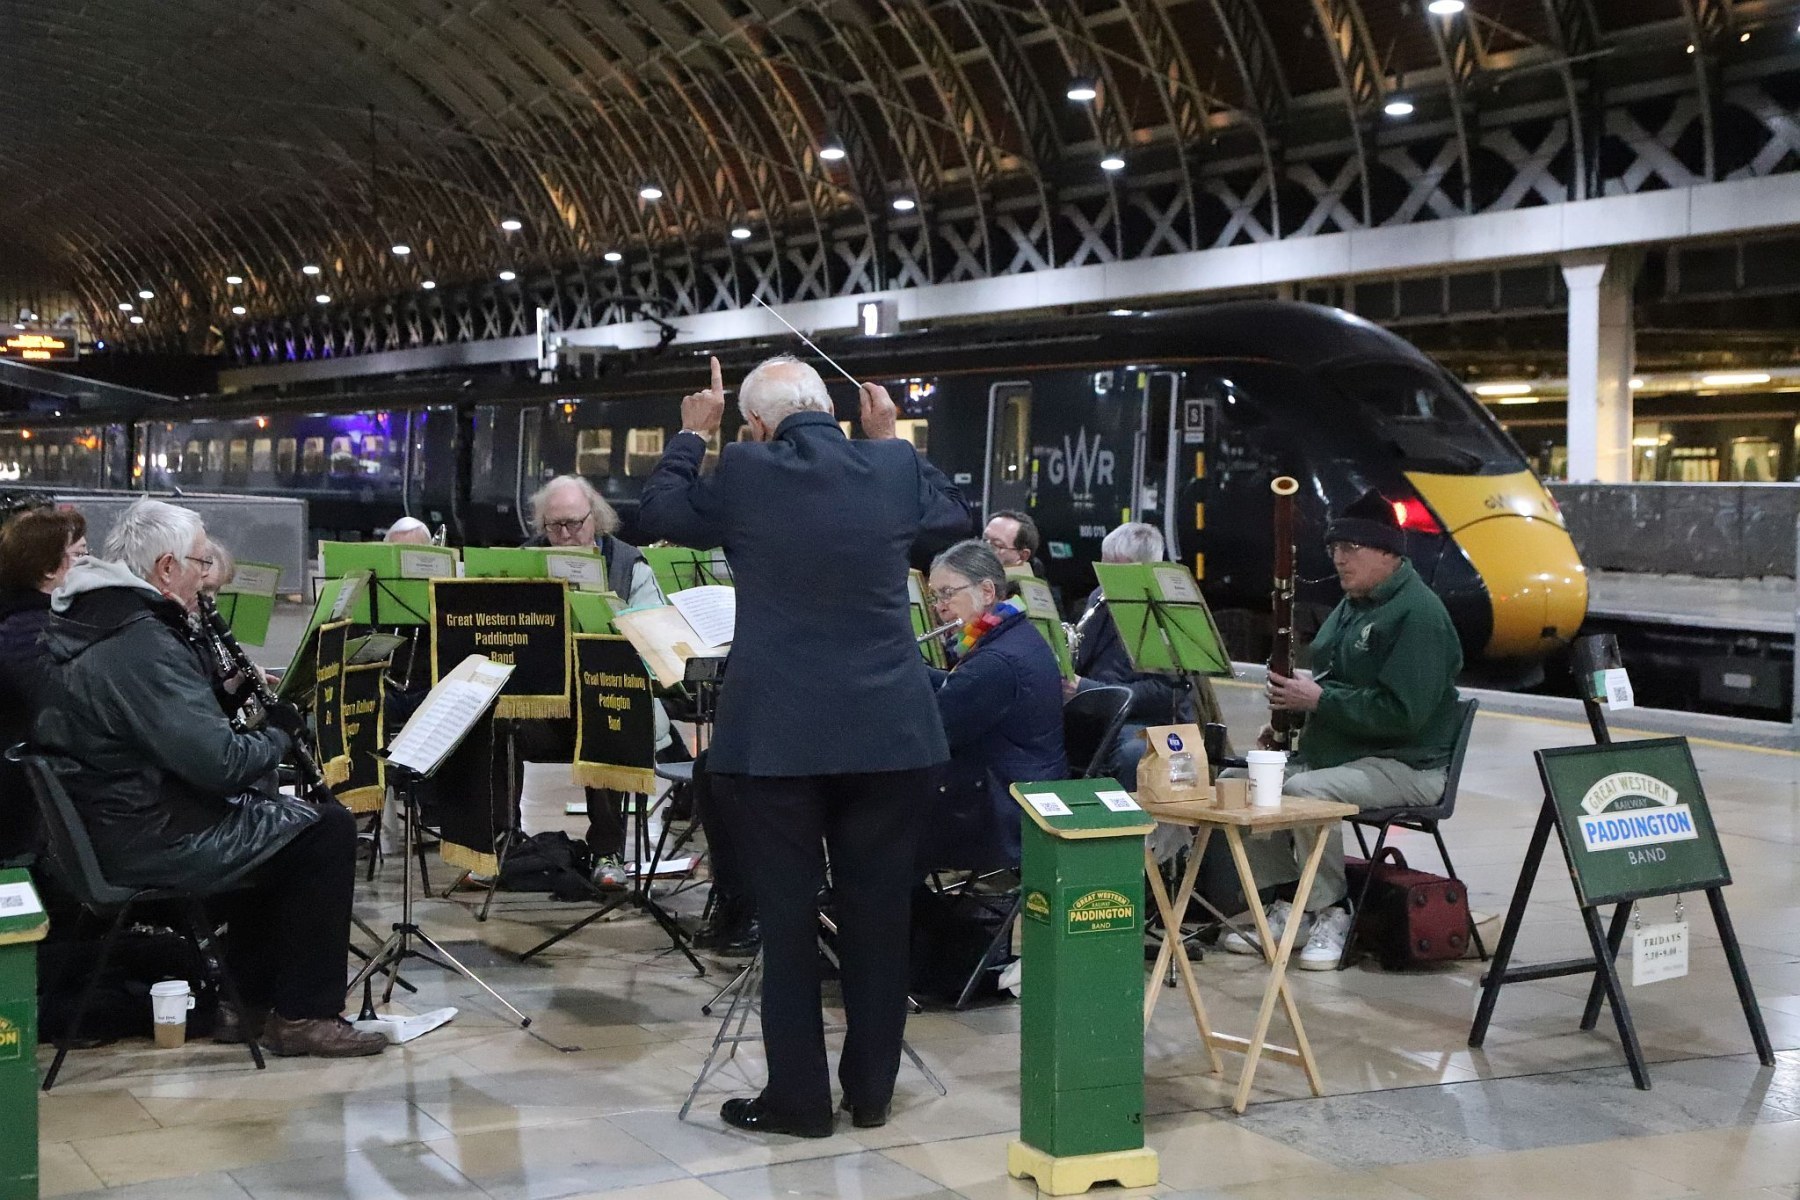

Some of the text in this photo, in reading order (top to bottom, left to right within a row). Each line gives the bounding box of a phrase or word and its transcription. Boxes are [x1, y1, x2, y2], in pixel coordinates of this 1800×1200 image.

[1047, 425, 1115, 494] GWR
[446, 612, 556, 627] Great Western Railway
[475, 631, 529, 647] Paddington
[491, 651, 515, 664] Band
[1588, 776, 1669, 810] GREAT WESTERN
[1614, 798, 1648, 810] RAILWAY
[1585, 811, 1691, 844] PADDINGTON
[1628, 847, 1667, 865] BAND
[1076, 892, 1127, 908] GREAT WESTERN
[1070, 907, 1132, 922] PADDINGTON
[1091, 922, 1111, 930] BAND
[1644, 933, 1681, 947] FRIDAYS
